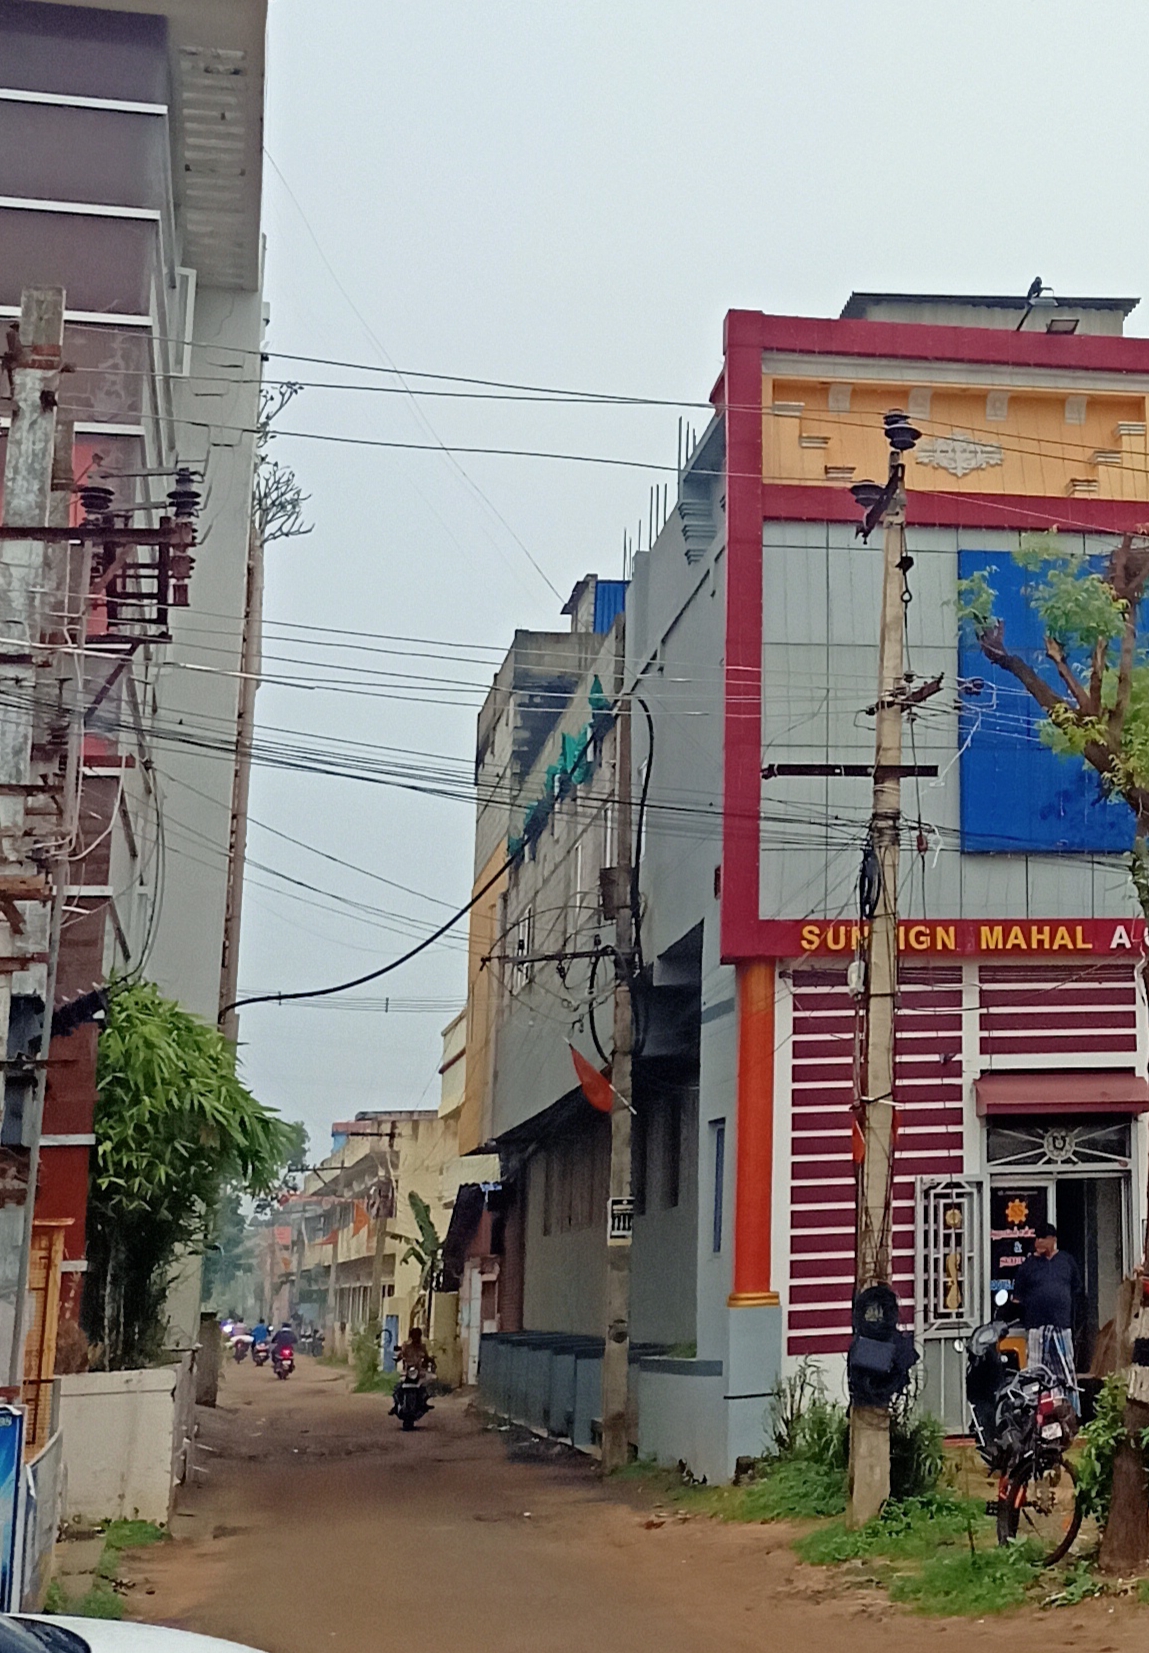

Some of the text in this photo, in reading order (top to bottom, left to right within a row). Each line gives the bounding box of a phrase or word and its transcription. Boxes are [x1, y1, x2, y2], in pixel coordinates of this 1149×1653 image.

[801, 925, 869, 950] SUN
[899, 925, 956, 950] IGN
[981, 925, 1093, 950] MAHAL
